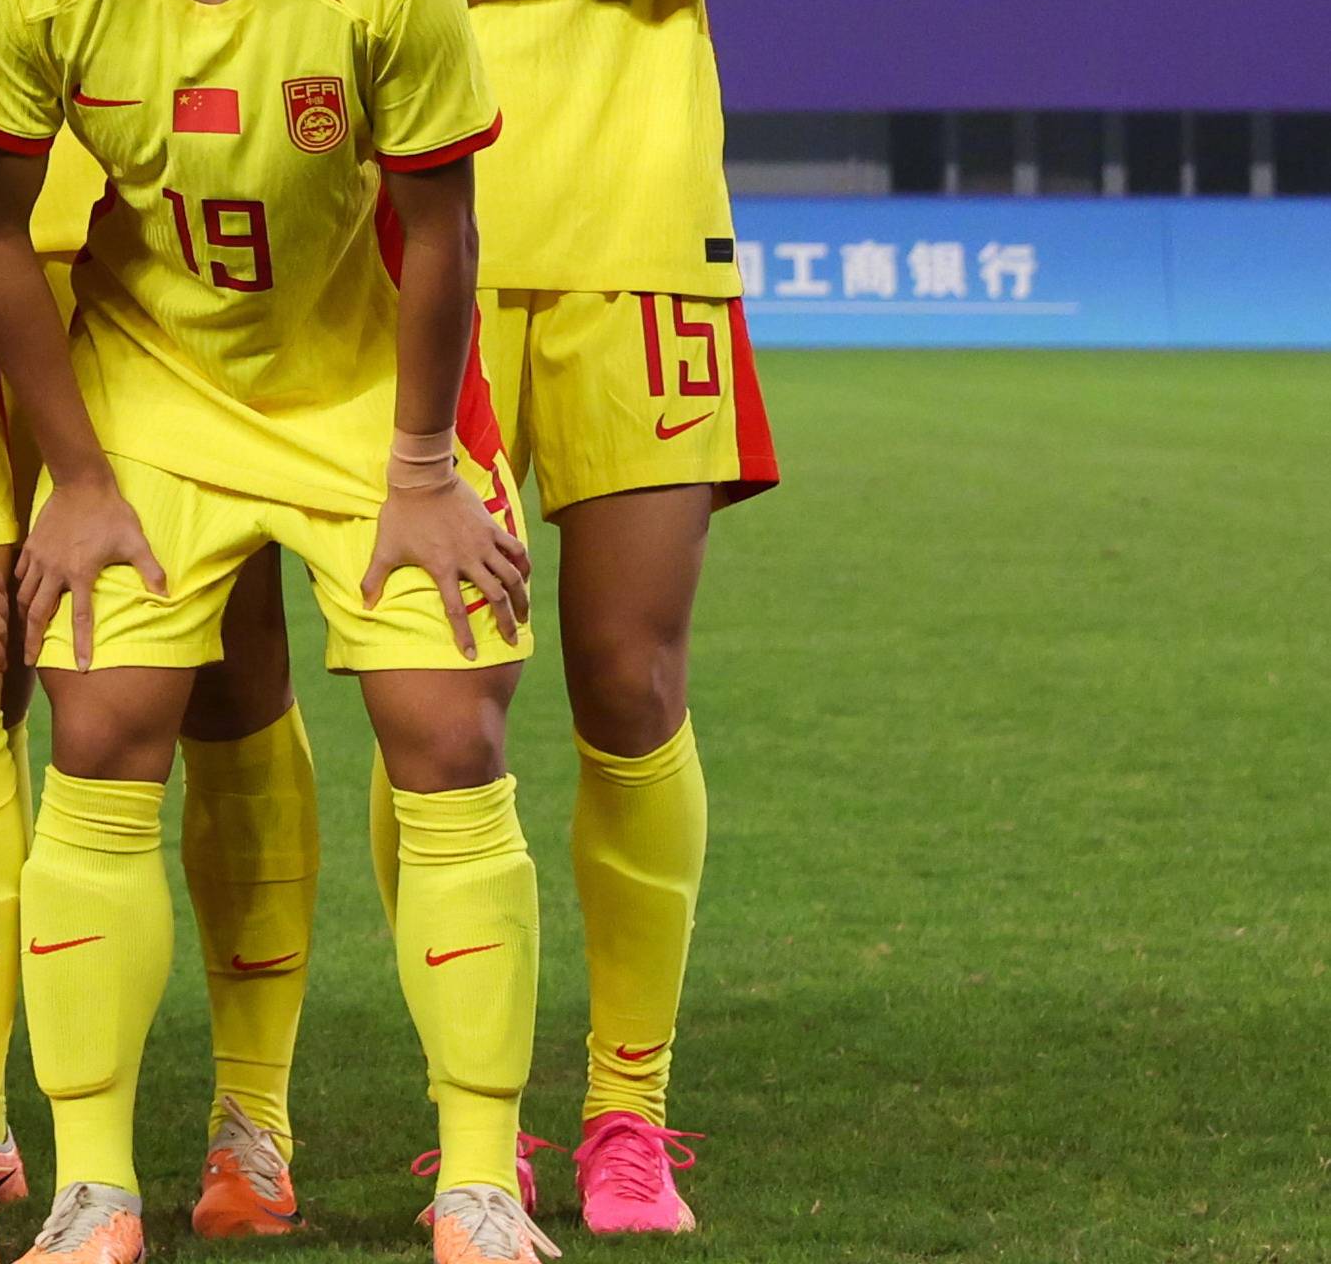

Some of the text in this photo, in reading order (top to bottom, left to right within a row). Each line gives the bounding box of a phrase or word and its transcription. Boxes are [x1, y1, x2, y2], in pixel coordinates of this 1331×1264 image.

[290, 83, 336, 100] CFA
[162, 187, 274, 293] 19
[640, 292, 721, 397] 15
